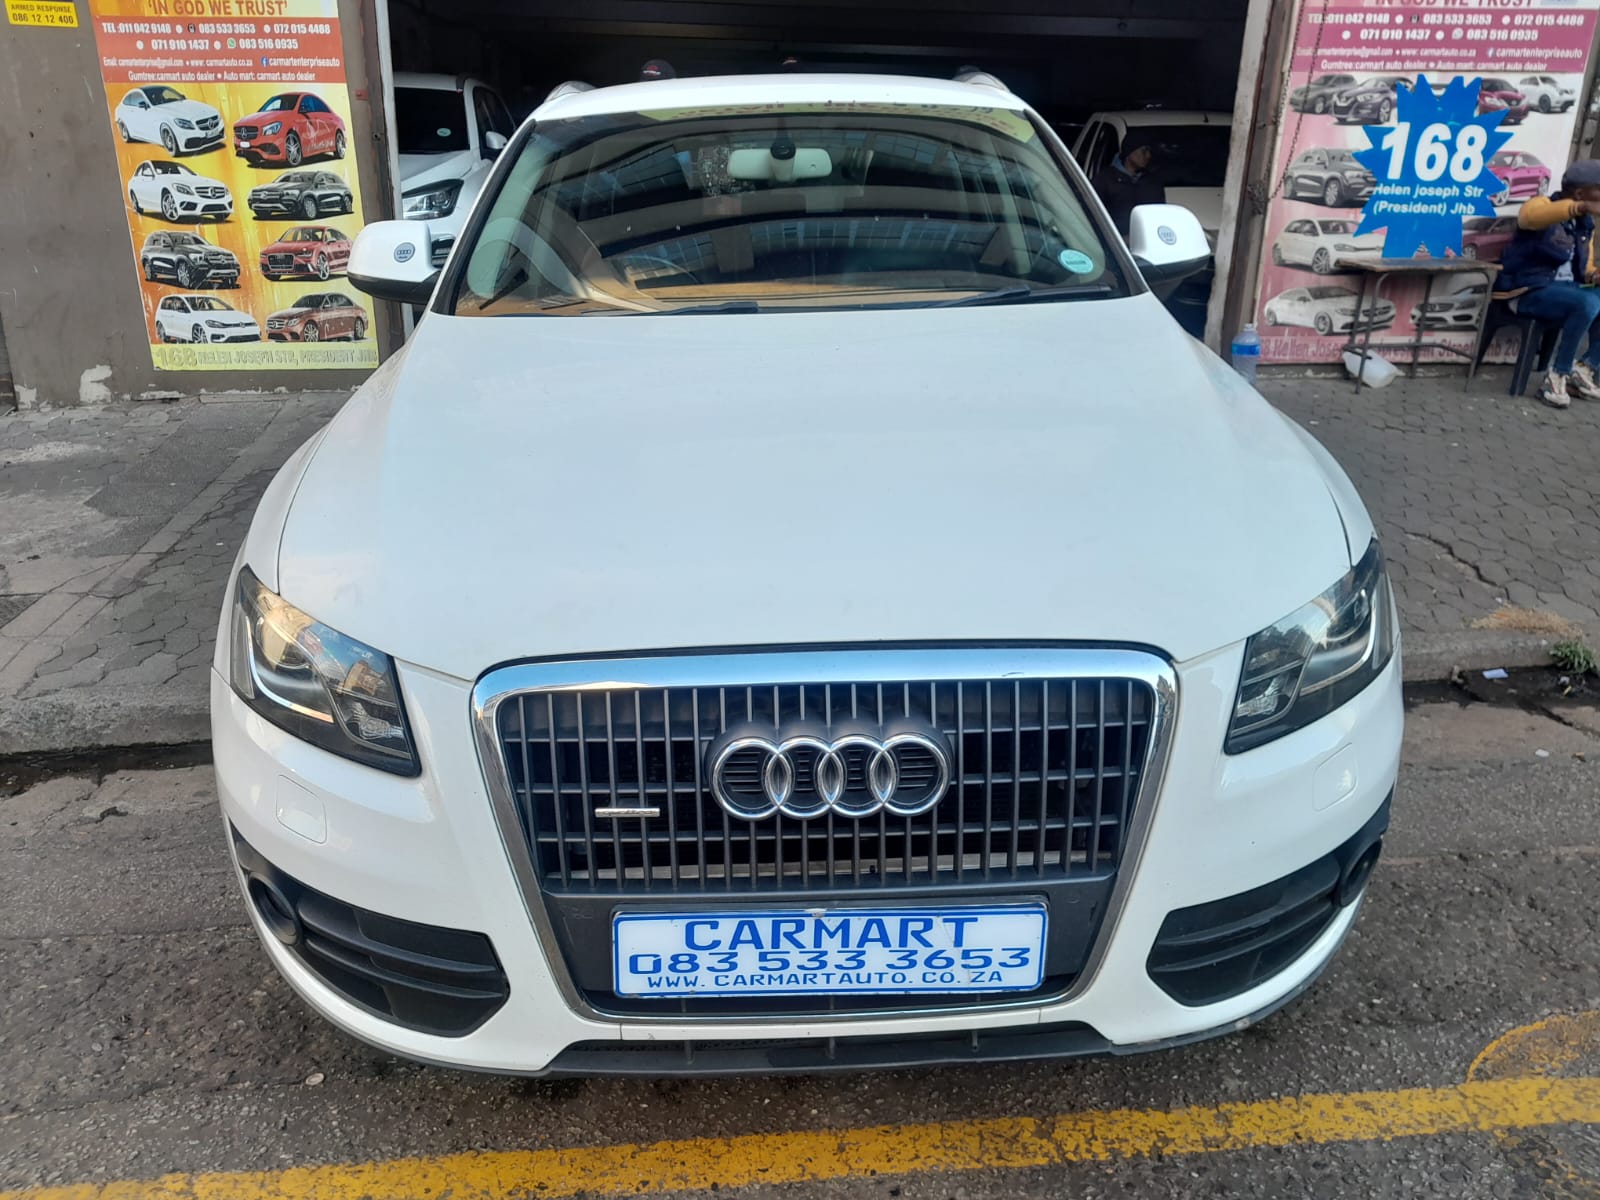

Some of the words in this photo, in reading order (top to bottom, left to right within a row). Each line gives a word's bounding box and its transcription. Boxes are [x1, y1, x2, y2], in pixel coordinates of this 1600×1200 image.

[173, 0, 204, 14] GOD
[208, 0, 231, 15] WE
[12, 13, 28, 22] 086
[32, 14, 41, 23] 12
[45, 15, 55, 23] 12
[59, 16, 74, 24] 400
[134, 23, 150, 33] 042
[198, 23, 215, 34] 083
[216, 23, 232, 34] 533
[234, 23, 256, 34] 3653
[274, 23, 289, 34] 072
[291, 23, 307, 34] 015
[151, 39, 168, 50] 071
[169, 39, 186, 50] 910
[188, 39, 209, 50] 1437
[239, 38, 256, 49] 083
[258, 38, 274, 49] 516
[275, 38, 298, 49] 0935
[1381, 121, 1488, 183] 168
[1413, 184, 1460, 199] joseph
[1463, 185, 1484, 198] Str
[1373, 200, 1447, 216] (President)
[1450, 203, 1475, 216] Jhb
[684, 917, 978, 951] CARMART
[629, 953, 739, 975] 083
[758, 950, 866, 973] 533
[886, 947, 1031, 970] 3653
